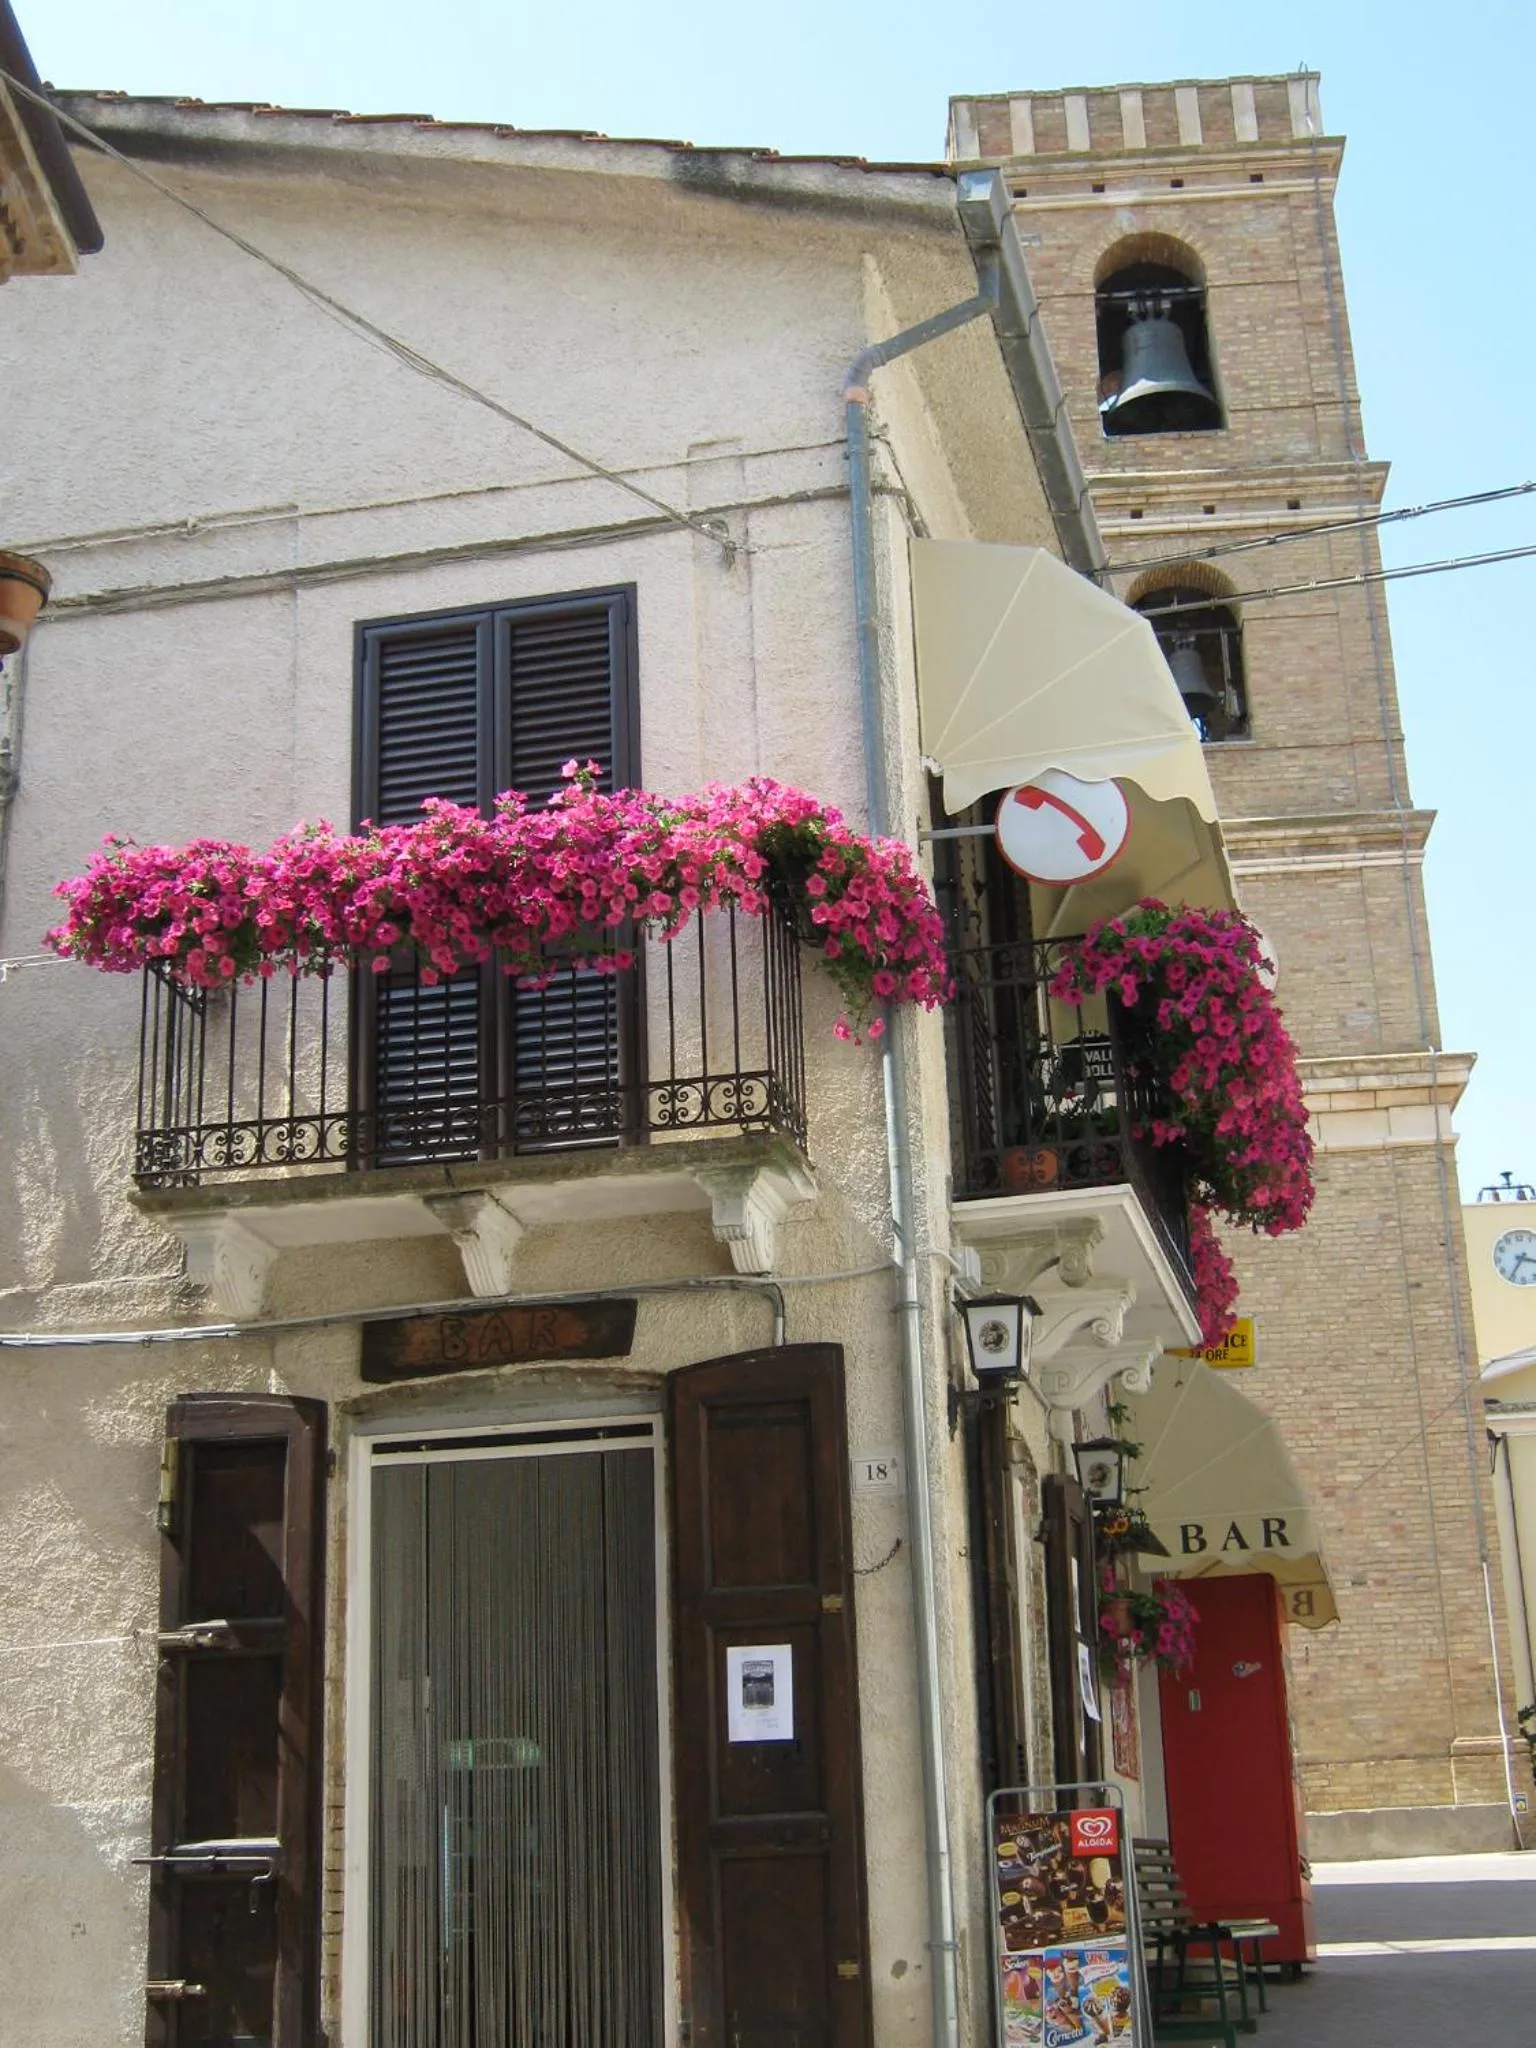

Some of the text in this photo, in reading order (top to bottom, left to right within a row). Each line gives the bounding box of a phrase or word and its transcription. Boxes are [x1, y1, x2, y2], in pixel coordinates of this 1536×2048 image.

[439, 1308, 558, 1360] BAR
[1223, 1333, 1248, 1348] ICE
[866, 1463, 887, 1480] 18
[1180, 1517, 1291, 1554] BAR
[1078, 1837, 1114, 1848] ALGIDA
